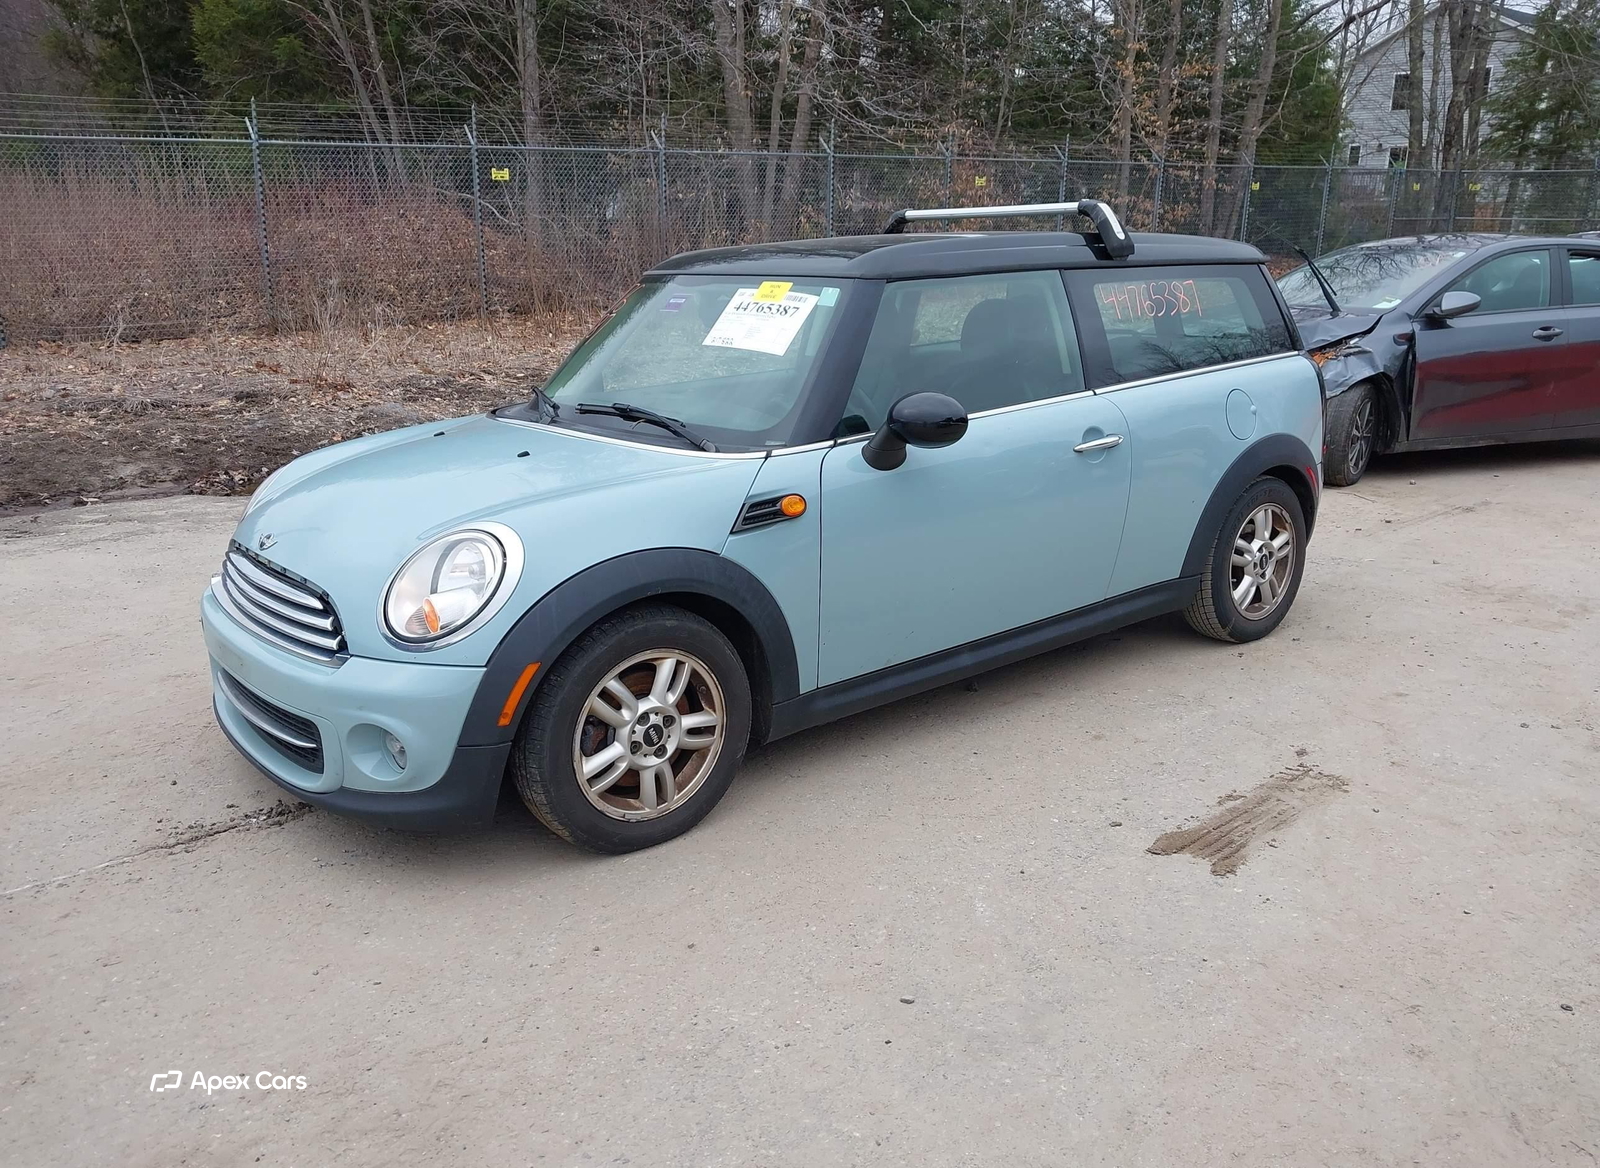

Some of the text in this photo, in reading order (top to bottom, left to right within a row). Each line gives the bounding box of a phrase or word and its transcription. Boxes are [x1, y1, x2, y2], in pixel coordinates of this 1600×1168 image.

[733, 301, 800, 318] 44765387
[1099, 280, 1202, 322] 44765387
[648, 727, 659, 744] MINI
